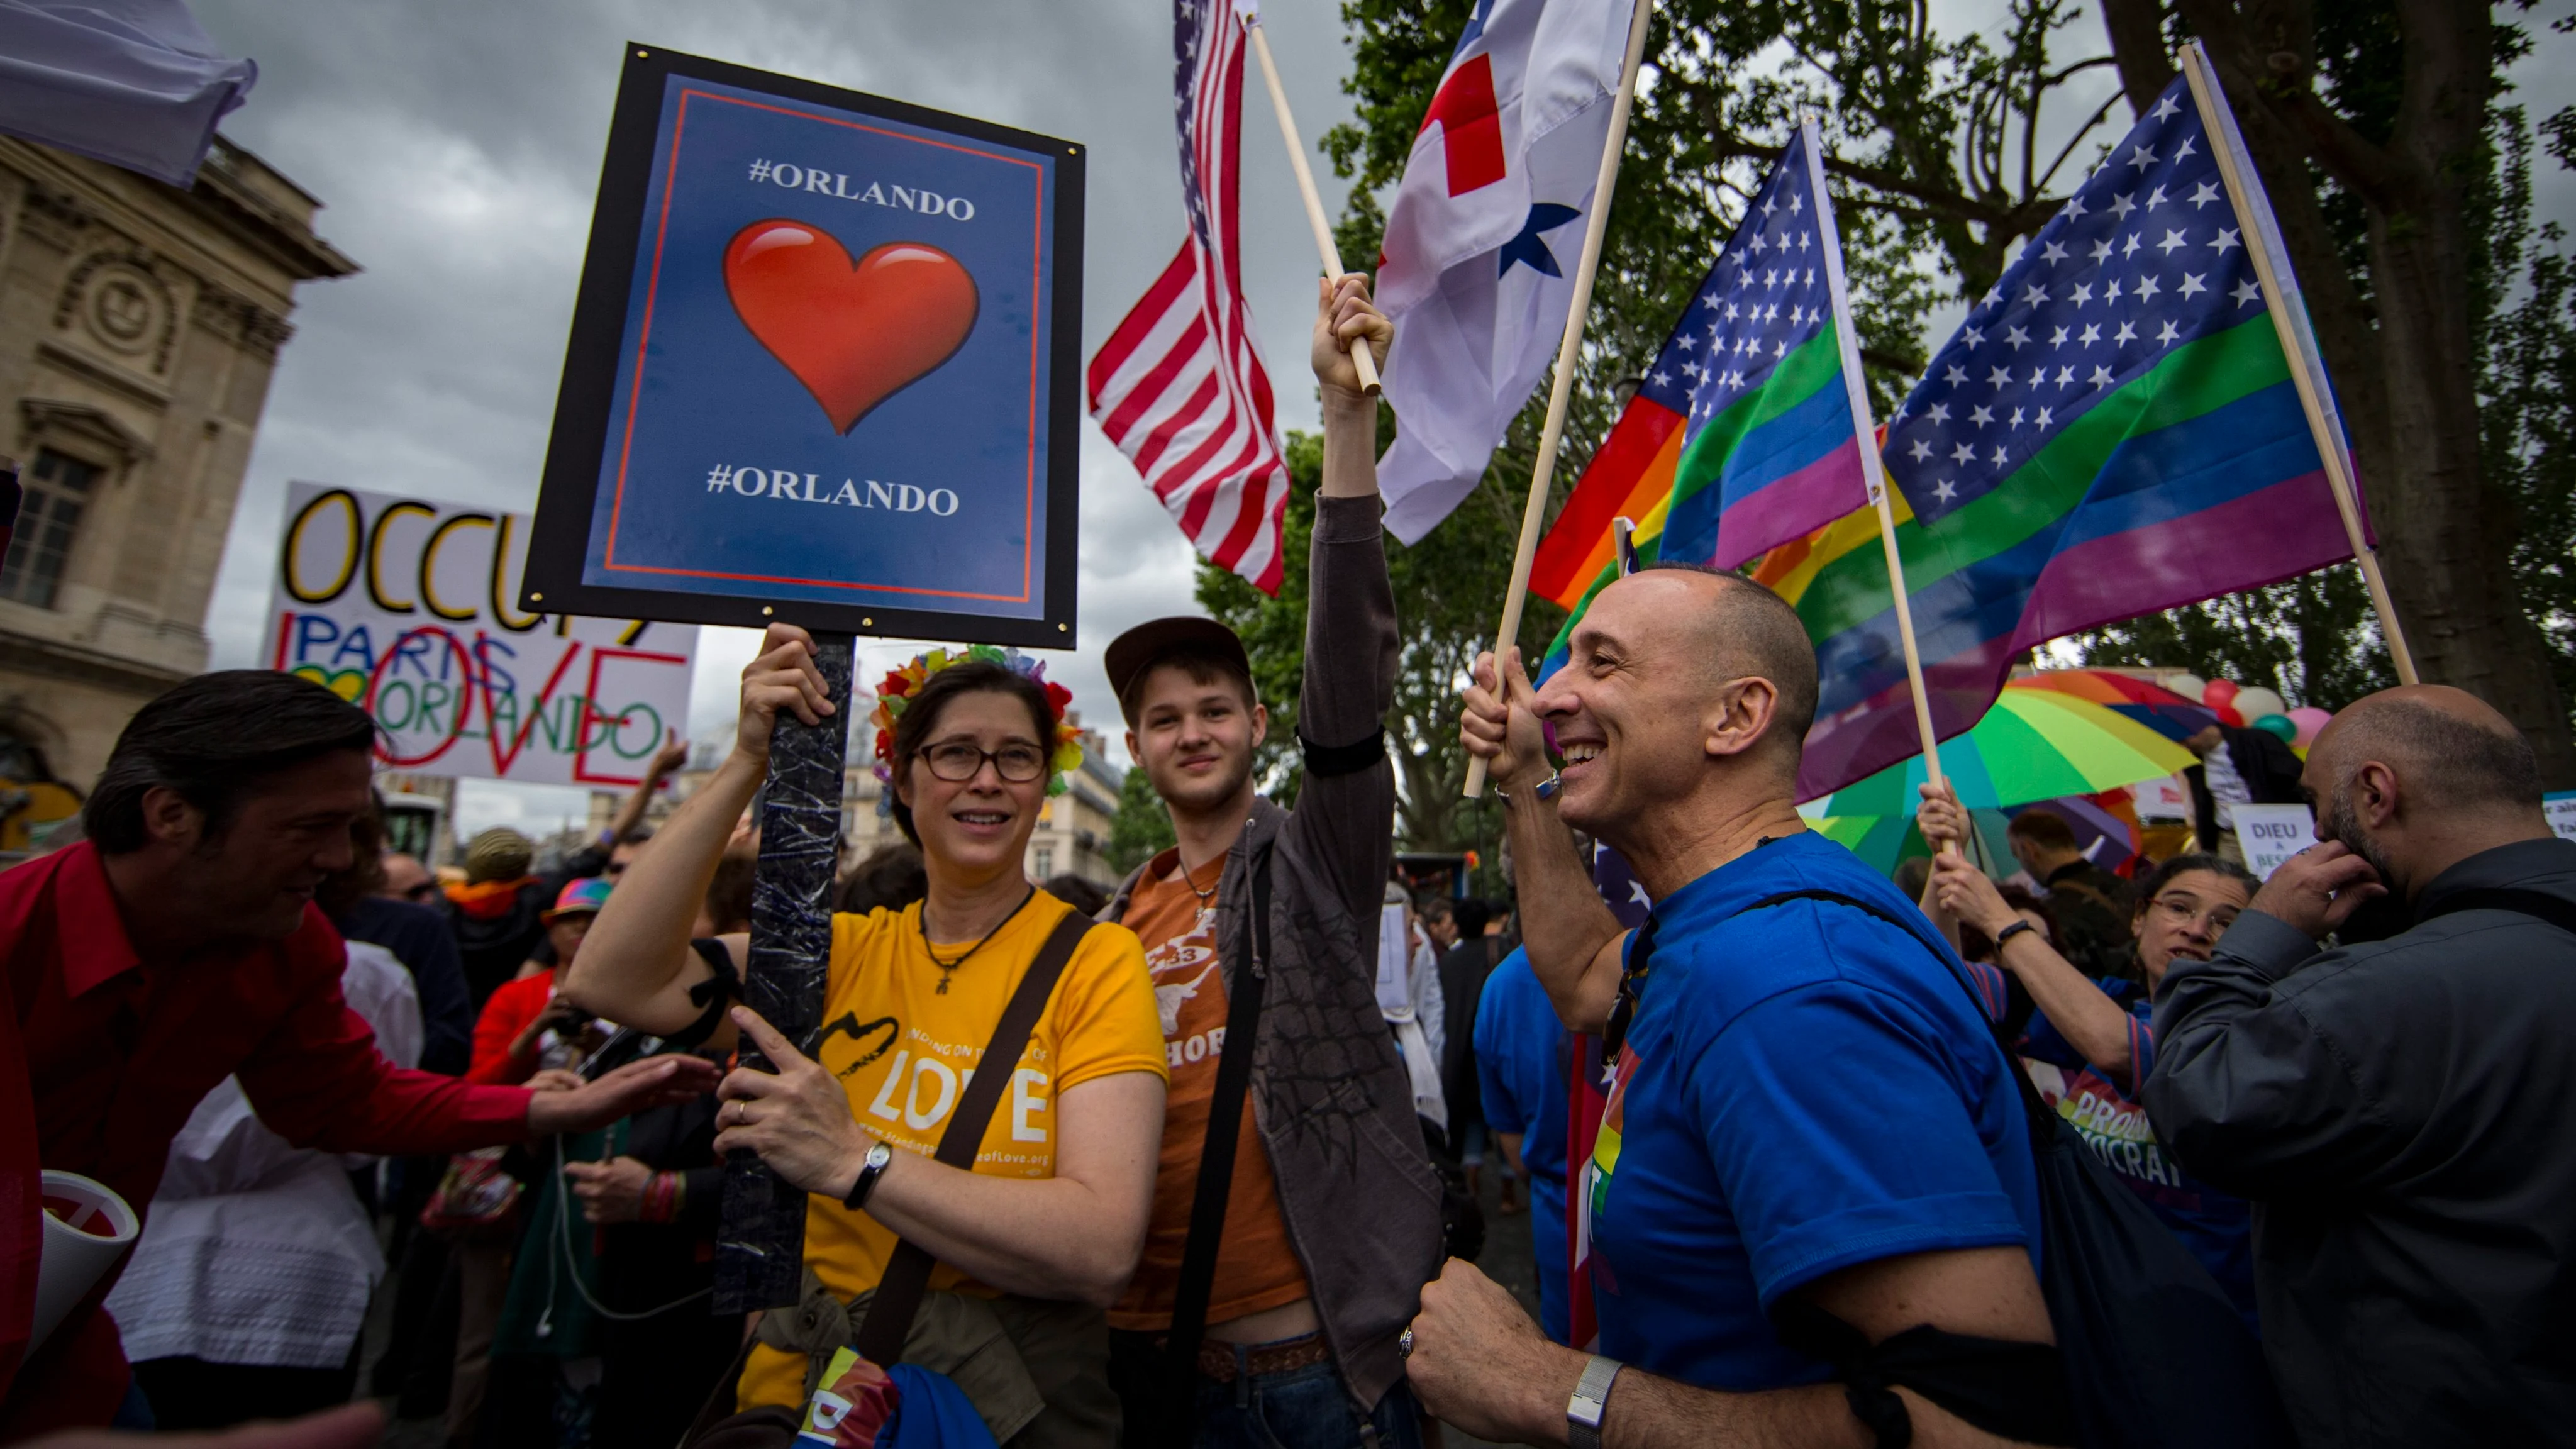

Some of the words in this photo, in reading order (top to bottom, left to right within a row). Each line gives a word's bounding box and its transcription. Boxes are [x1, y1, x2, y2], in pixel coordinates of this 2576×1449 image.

[748, 158, 975, 222] #ORLANDO
[706, 463, 960, 517] #ORLANDO
[281, 489, 652, 647] OCCU
[294, 614, 518, 693] PARIS
[376, 680, 662, 760] ORLANDO
[2251, 823, 2297, 840] DIEU
[953, 1044, 974, 1058] ON
